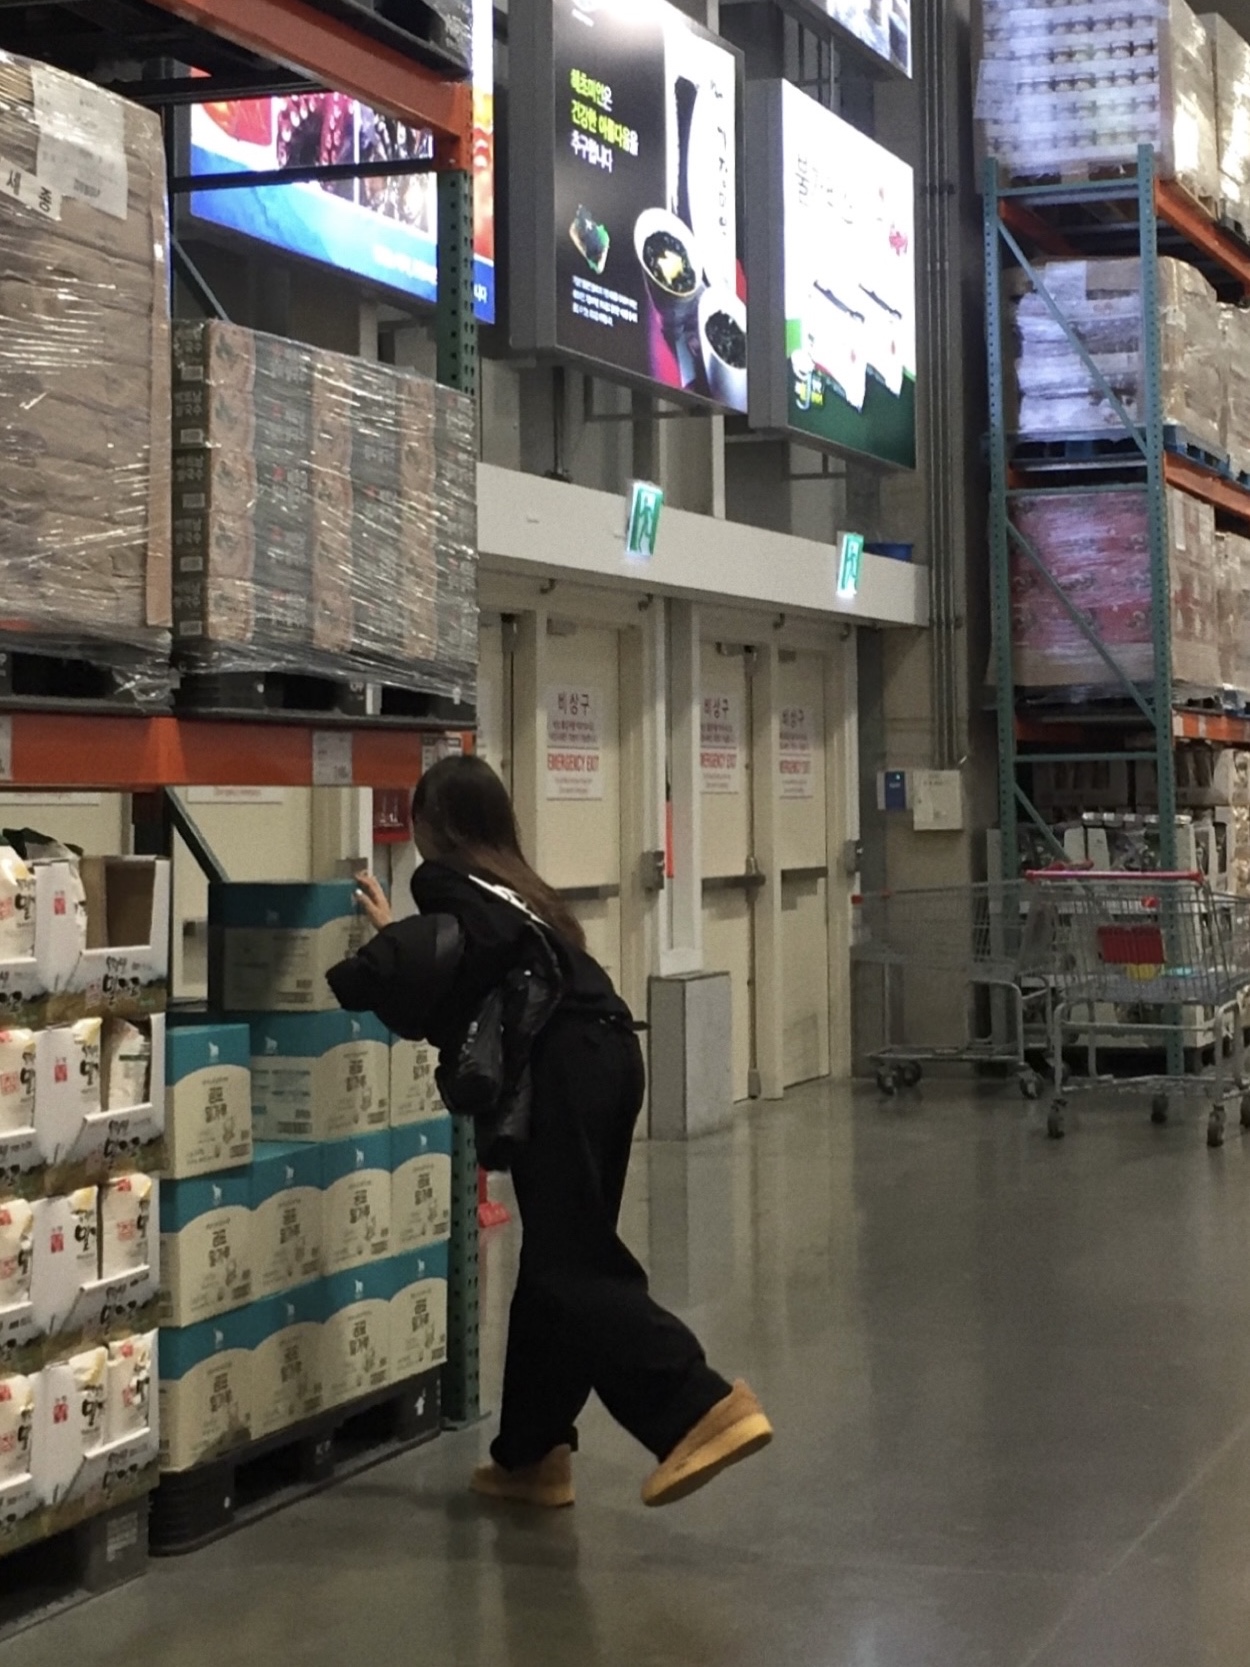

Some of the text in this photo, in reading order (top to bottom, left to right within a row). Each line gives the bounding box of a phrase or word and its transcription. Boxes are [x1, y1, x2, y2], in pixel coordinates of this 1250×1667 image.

[571, 99, 639, 157] 건강한 아름다움을
[571, 130, 613, 173] 추구합니다
[557, 692, 590, 716] 비상구
[547, 753, 599, 771] EMERGENCY EXIT
